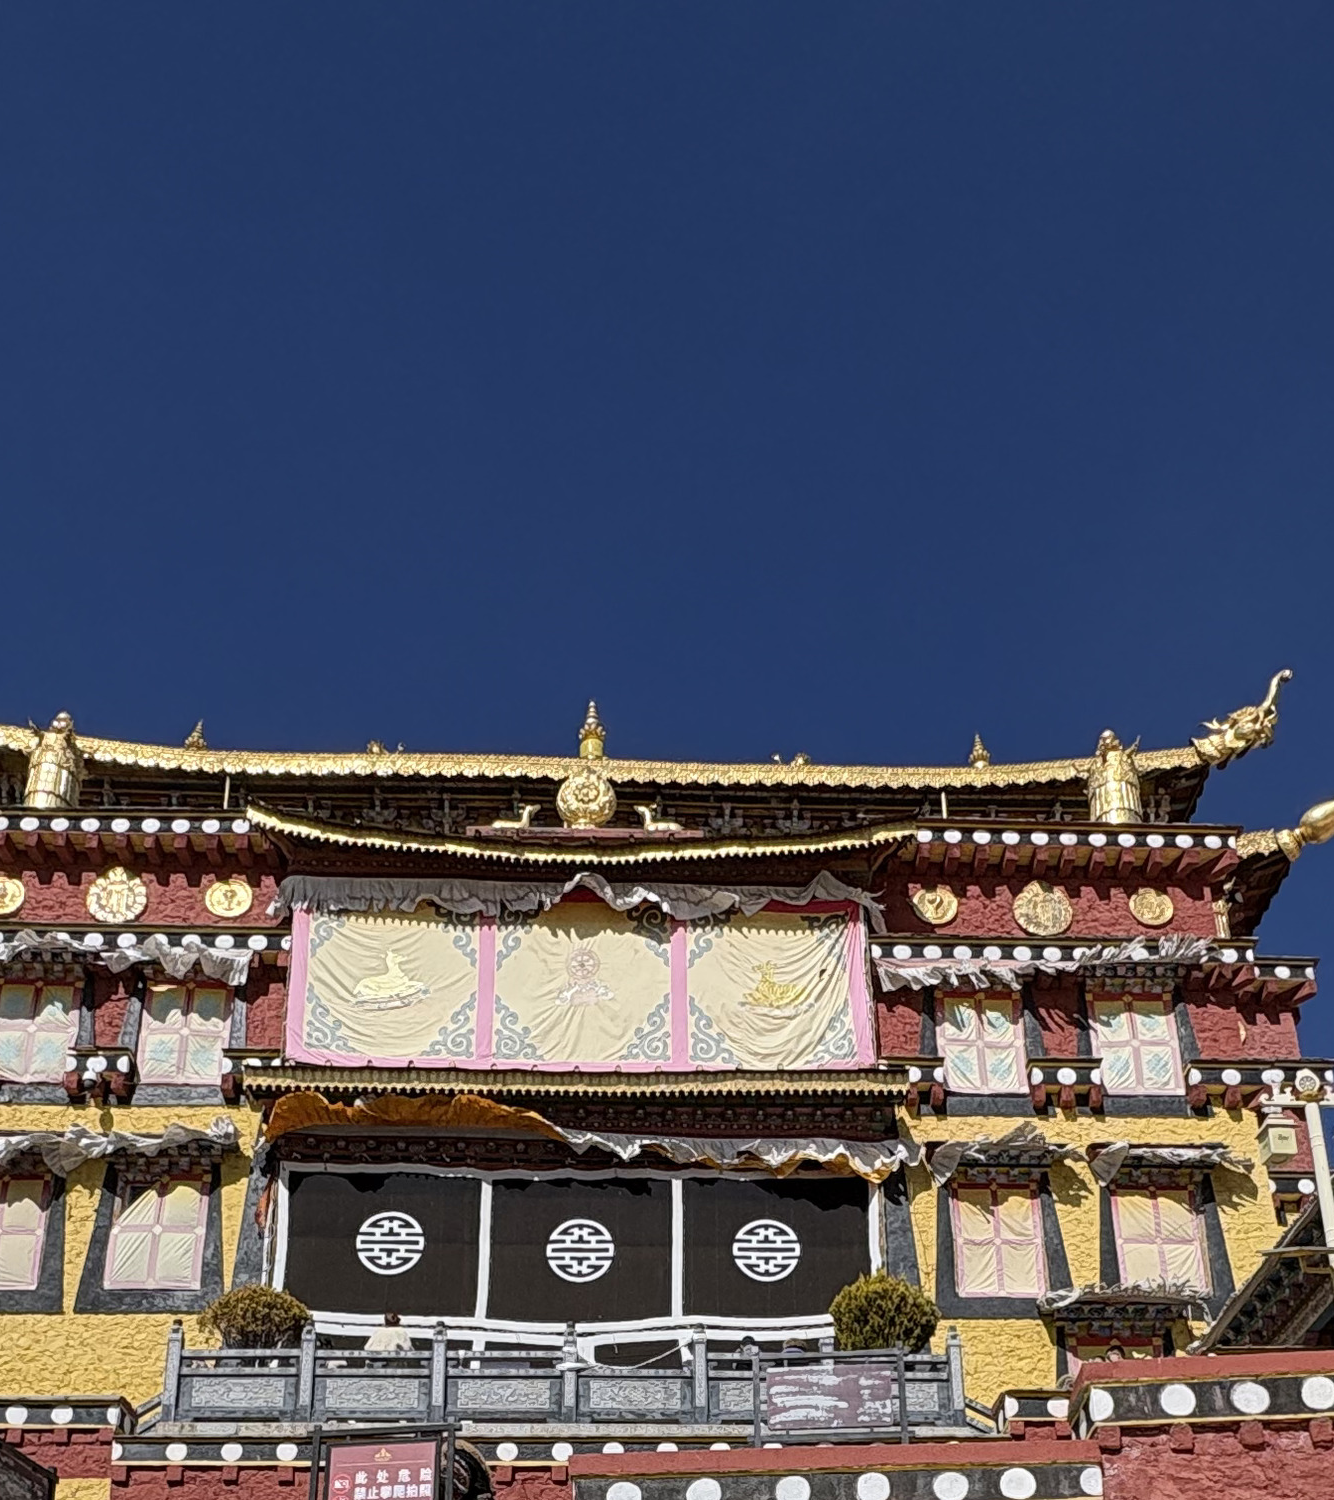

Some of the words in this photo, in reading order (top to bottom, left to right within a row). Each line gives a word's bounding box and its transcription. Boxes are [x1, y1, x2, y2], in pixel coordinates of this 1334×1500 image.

[355, 1467, 432, 1485] 此处危险
[354, 1483, 432, 1500] 禁止攀爬拍照
